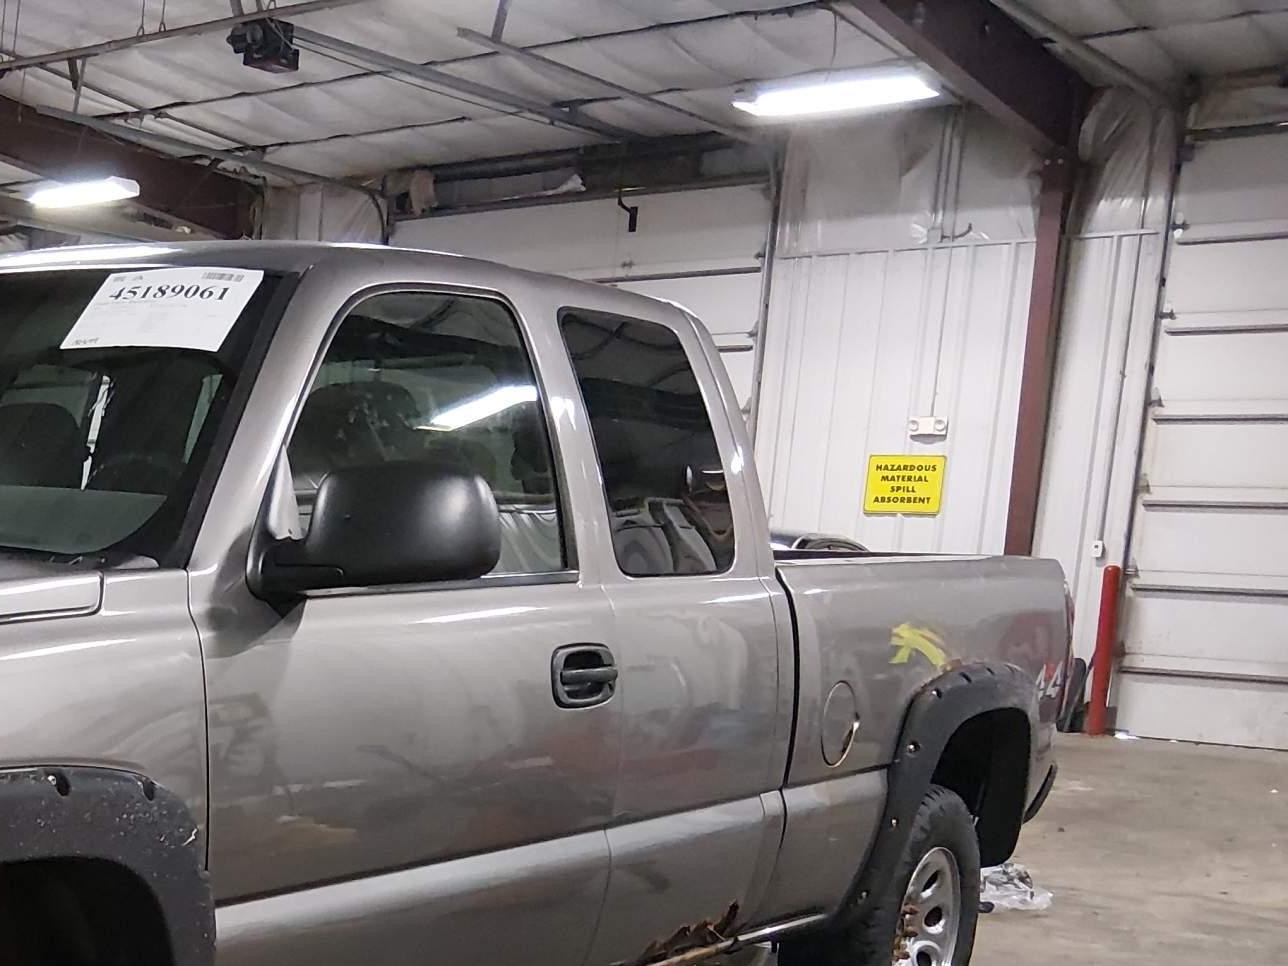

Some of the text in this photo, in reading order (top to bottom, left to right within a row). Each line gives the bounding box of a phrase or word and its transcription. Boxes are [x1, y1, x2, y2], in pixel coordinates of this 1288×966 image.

[108, 284, 230, 300] 45189061
[875, 464, 937, 472] HAZARDOUS
[890, 485, 917, 493] SPILL
[873, 496, 931, 504] ABSORBENT
